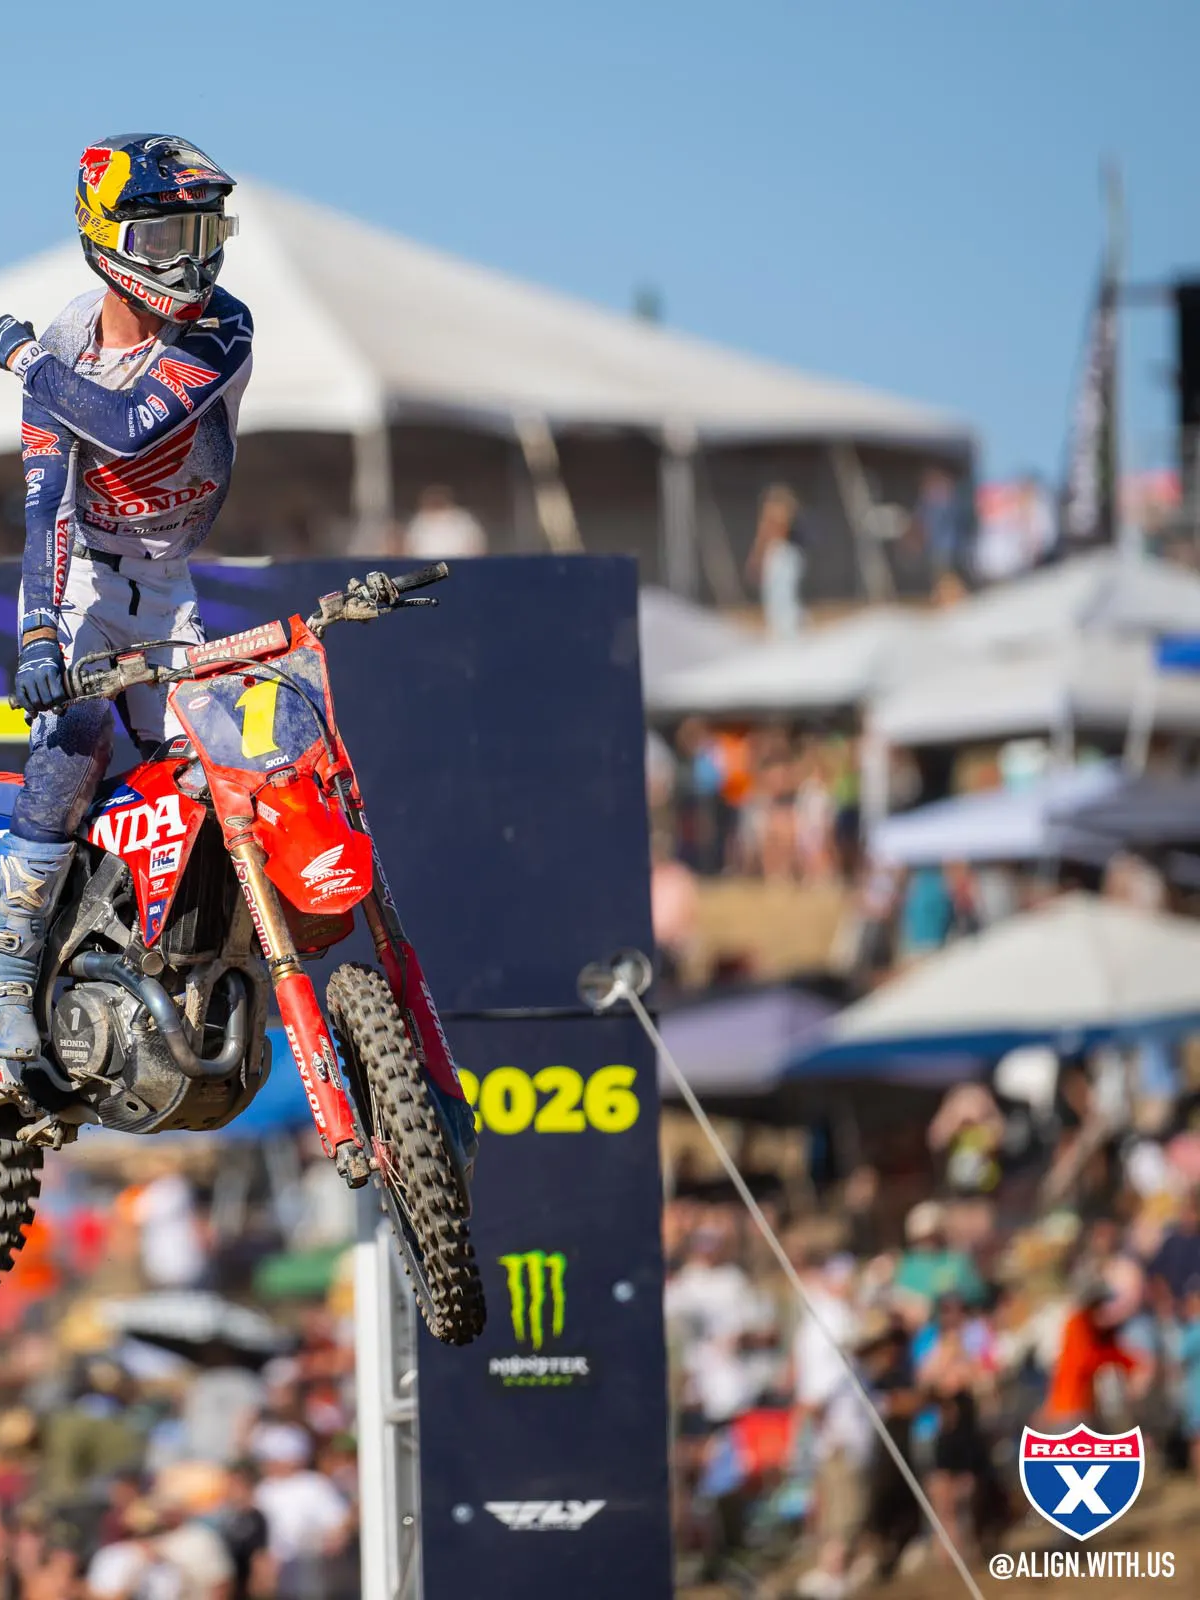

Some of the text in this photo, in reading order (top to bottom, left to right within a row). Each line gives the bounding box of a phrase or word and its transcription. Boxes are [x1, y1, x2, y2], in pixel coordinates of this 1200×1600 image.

[98, 255, 174, 316] Red Bull
[148, 367, 194, 413] HONDA
[22, 447, 62, 461] ONDA
[89, 479, 220, 517] HONDA
[45, 529, 53, 568] SUPERTECH
[53, 517, 70, 607] HONDA
[193, 623, 275, 656] RENTHAL
[234, 675, 282, 760] 1
[92, 794, 187, 856] NDA
[152, 847, 176, 869] HRC
[304, 868, 356, 888] HONDA
[70, 1007, 81, 1031] 1
[59, 1038, 91, 1049] HONDA
[284, 1023, 327, 1129] DUNLOP
